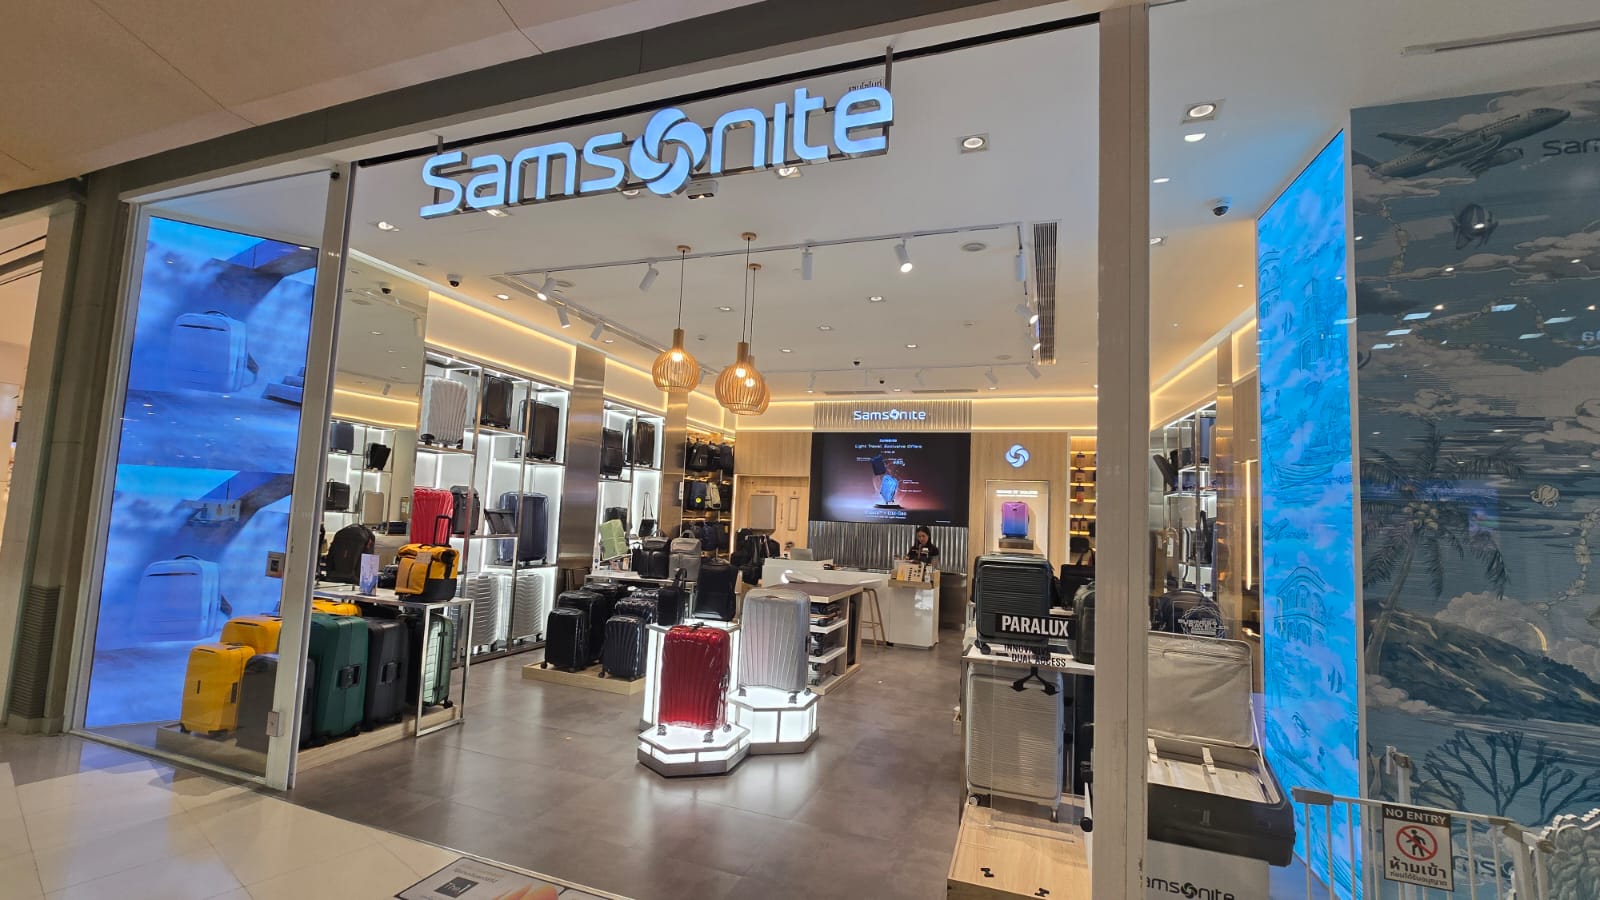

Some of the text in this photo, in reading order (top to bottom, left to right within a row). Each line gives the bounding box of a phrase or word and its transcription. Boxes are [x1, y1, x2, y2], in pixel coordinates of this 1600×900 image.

[420, 86, 894, 219] Samsonite
[853, 409, 927, 421] Samsonite
[1001, 615, 1069, 637] PARALUX
[1012, 653, 1032, 665] DUAL
[1385, 807, 1446, 825] NO ENTRY
[1389, 856, 1447, 879] ห้ามเข้า
